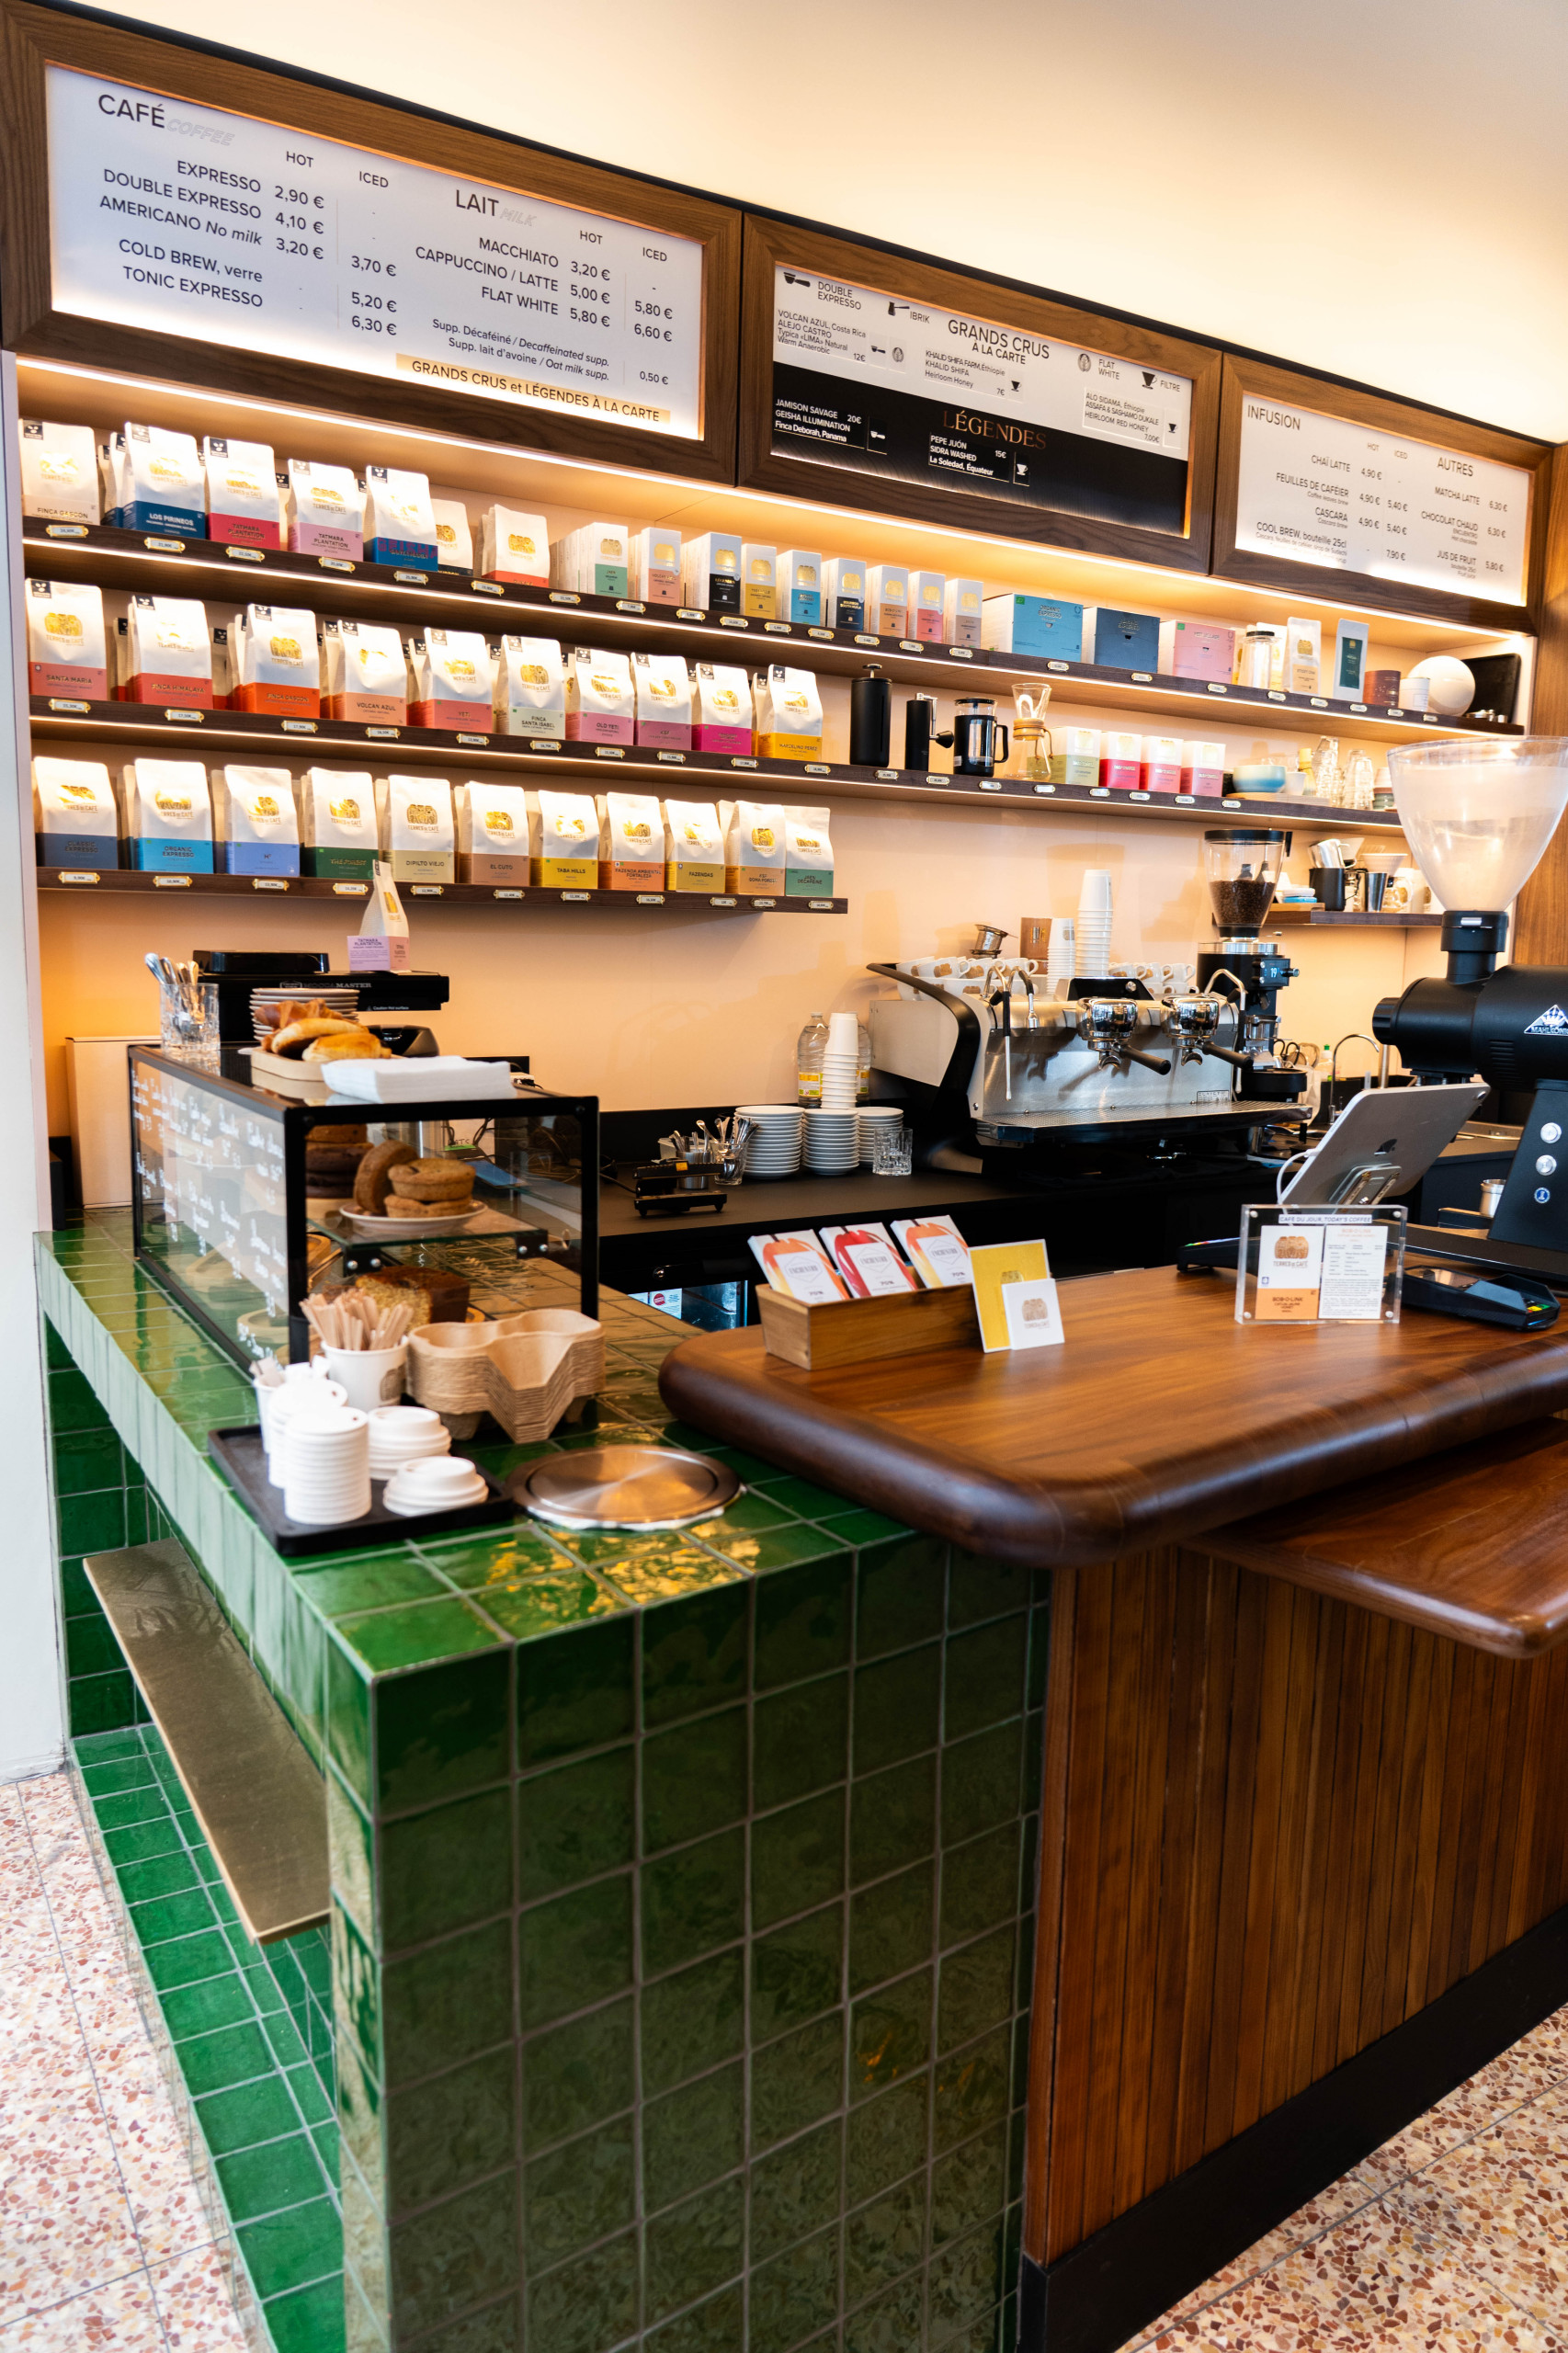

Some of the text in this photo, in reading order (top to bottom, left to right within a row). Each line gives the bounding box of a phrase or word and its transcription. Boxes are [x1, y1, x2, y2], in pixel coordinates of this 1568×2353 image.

[97, 95, 235, 146] CAFÉ COFFEE
[286, 151, 314, 168] HOT
[177, 160, 261, 192] EXPRESSO
[359, 171, 389, 188] ICED
[104, 168, 261, 219] DOUBLE EXPRESSO
[275, 186, 324, 209] 2,90 €
[455, 189, 538, 227] LAIT MILK
[99, 195, 263, 245] AMERICANO No milk
[275, 211, 324, 234] 4,10 €
[580, 230, 603, 245] HOT
[276, 237, 324, 260] 3,20 €
[479, 237, 559, 268] MACCHIATO
[642, 246, 667, 263] ICED
[119, 239, 263, 283] COLD BREW, verre
[351, 256, 396, 277] 3,70 €
[415, 246, 559, 292] CAPPUCCINO LATTE
[570, 260, 610, 281] 3,20 €
[123, 266, 263, 308] TONIC EXPRESSO
[570, 284, 610, 304] 5,00 €
[818, 281, 853, 298] DOUBLE
[351, 292, 397, 313] 5,20 €
[482, 286, 559, 316] FLAT WHITE
[634, 300, 673, 320] 5,80 €
[818, 290, 862, 310] EXPRESSO
[351, 316, 397, 336] 6,30 €
[570, 307, 610, 327] 5,80 €
[778, 309, 867, 338] VOLCAN AZUL, Costa Rica
[910, 311, 930, 324] IBRIK
[634, 323, 673, 342] 6,60 €
[778, 319, 832, 338] ALEJO CASTRO
[433, 318, 609, 369] Supp. Décaféiné Decaffeinated supp.
[778, 327, 800, 339] Typica
[824, 339, 848, 351] Natural
[778, 335, 831, 355] Warm Anaerobic
[949, 319, 1050, 359] GRANDS CRUS
[449, 336, 477, 355] Supp.
[480, 344, 494, 357] lait
[545, 358, 563, 371] Oat
[565, 362, 584, 376] milk
[585, 368, 609, 381] supp.
[853, 353, 866, 362] 12€
[971, 339, 1027, 365] À LA CARTE
[925, 359, 970, 377] KHALID SHIFA
[1098, 358, 1116, 369] FLAT
[639, 370, 669, 385] 0,50 €
[925, 369, 974, 389] Heirloom Honey
[1098, 367, 1120, 381] WHITE
[412, 360, 660, 422] GRANDS CRUS et LÉGENDES À LA CARTE
[1160, 380, 1181, 392] FILTRE
[776, 398, 838, 419] JAMISON SAVAGE
[1246, 404, 1301, 431] INFUSION
[775, 409, 851, 432] GEISHA ILLUMINATION
[846, 414, 862, 425] 20€
[943, 410, 1047, 449] LÉGENDES
[775, 420, 847, 443] Finca Deborah, Panama
[930, 435, 948, 445] PEPE
[929, 445, 977, 462] SIDRA WASHED
[994, 449, 1007, 460] 15€
[929, 455, 994, 476] La Soledad, Équateur
[1330, 459, 1351, 472] LATTE
[1437, 456, 1474, 477] AUTRES
[1276, 472, 1309, 488] FEUILLES
[1309, 480, 1320, 491] DE
[1435, 485, 1481, 506] MATCHA LATTE
[37, 506, 88, 519] FINCA GASCON
[149, 512, 194, 527] LOS PIRINEOS
[1314, 506, 1348, 522] CASCARA
[1420, 510, 1479, 532] CHOCOLAT CHAUD
[313, 538, 348, 549] PLANTATION
[318, 532, 345, 542] TATMARA
[1256, 521, 1278, 534] COOL
[1279, 526, 1302, 540] BREW,
[1302, 531, 1332, 546] bouteille
[46, 674, 93, 685] SANTA MARIA
[357, 701, 396, 712] VOLCAN AZUL
